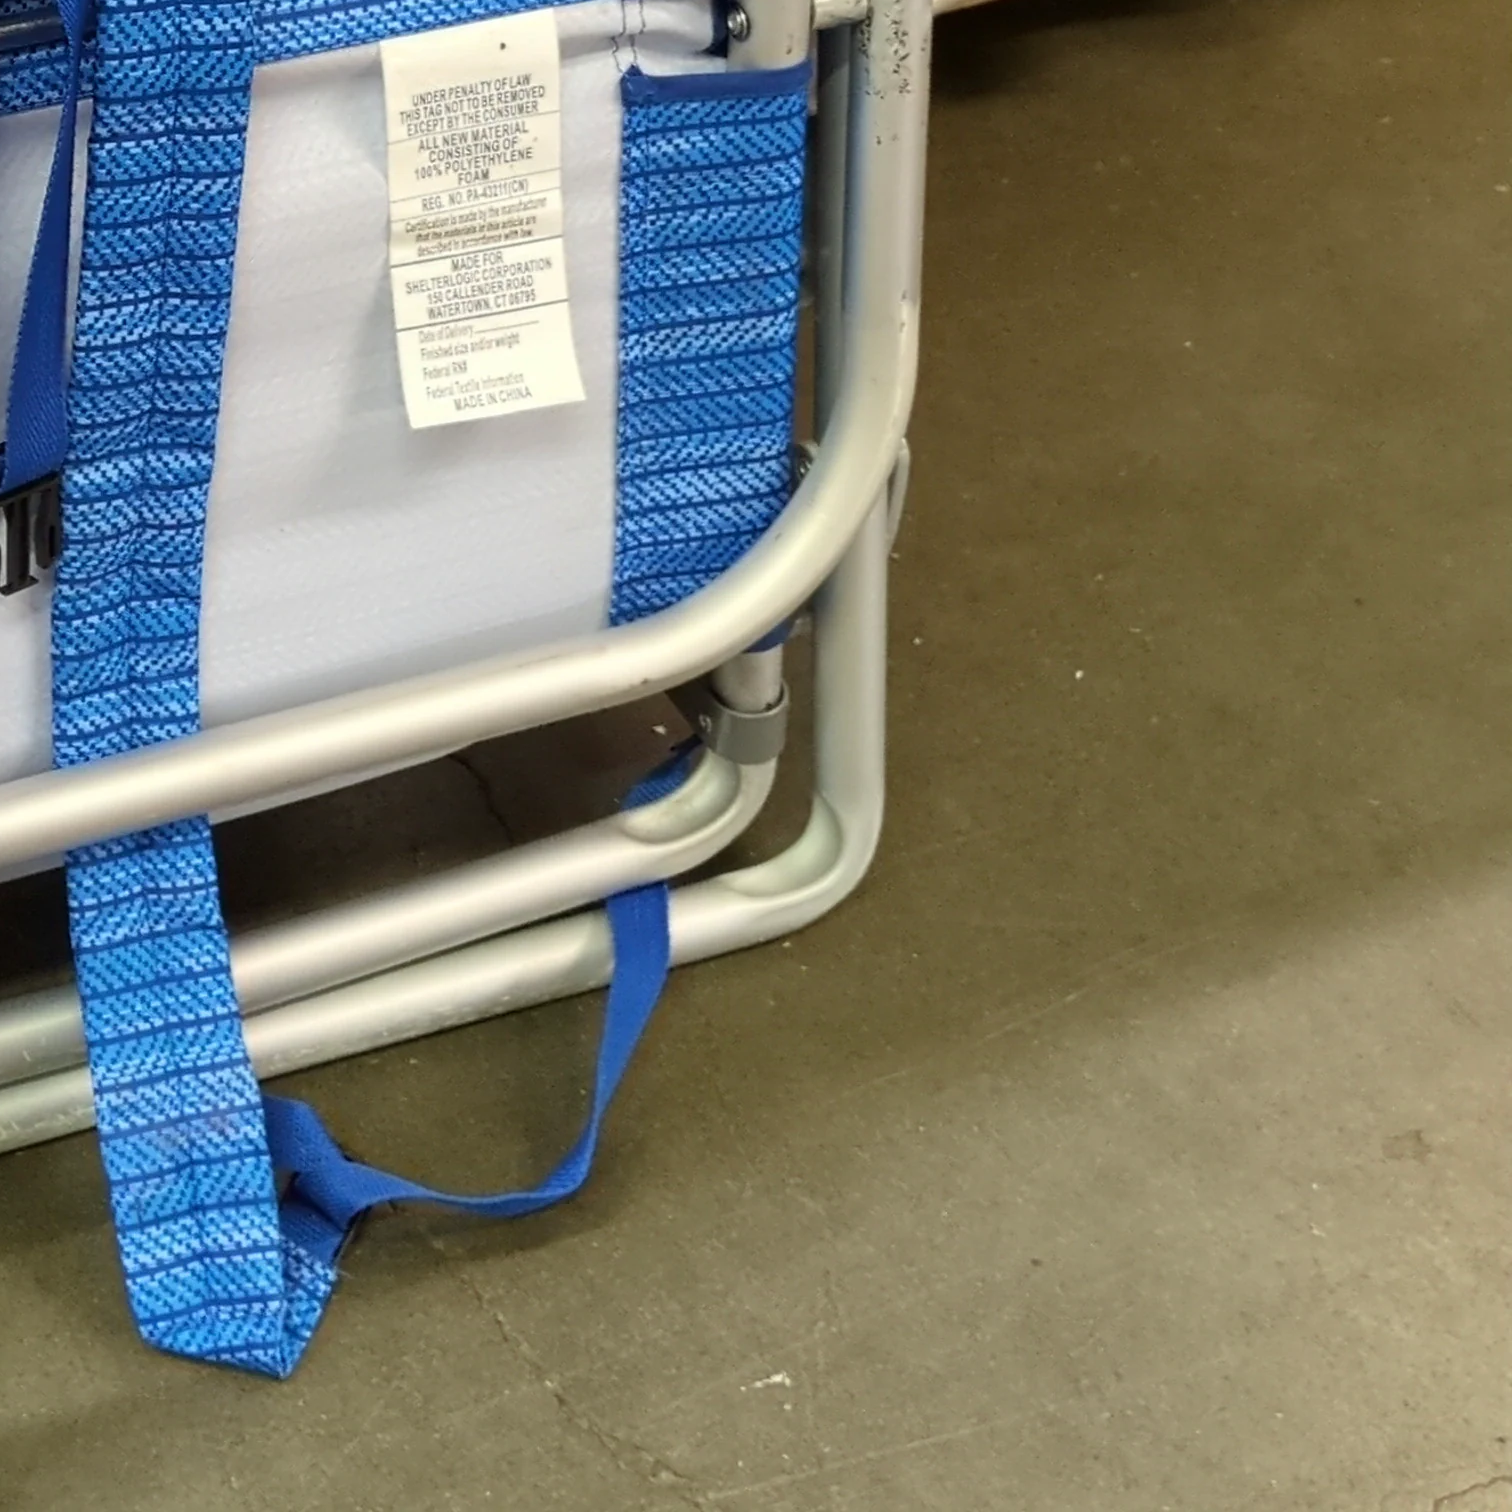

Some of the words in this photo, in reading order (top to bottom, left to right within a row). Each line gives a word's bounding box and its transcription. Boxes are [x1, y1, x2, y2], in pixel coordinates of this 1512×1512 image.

[413, 89, 446, 106] UNDER
[449, 80, 492, 99] PENALTY
[495, 78, 507, 91] OF
[510, 73, 531, 88] LAW
[400, 108, 421, 124] THIS
[423, 104, 442, 118] TAG
[445, 100, 465, 114] NOT
[467, 98, 479, 110] TO
[482, 95, 494, 107] BE
[498, 86, 545, 104] REMOVED
[407, 118, 444, 136] EXCEPT
[448, 115, 460, 128] BY
[463, 110, 481, 124] THE
[483, 101, 539, 121] CONSUMER
[419, 139, 439, 151] ALL
[442, 132, 468, 146] NEW
[472, 121, 528, 141] MATERIAL
[429, 140, 500, 162] CONSISTING
[503, 137, 518, 150] OF
[414, 164, 442, 180] 100%
[444, 147, 533, 174] POLYETHYLENE
[458, 168, 490, 185] FOAM
[422, 196, 444, 211] REG.
[405, 270, 480, 294] SHELTERLOGIC
[482, 257, 552, 281] CORPORATION
[452, 254, 480, 271] MADE
[483, 251, 504, 265] FOR
[427, 291, 442, 304] 150
[445, 280, 504, 301] CALLENDER
[506, 275, 533, 290] ROAD
[495, 294, 507, 308] CT
[454, 394, 485, 411] MADE
[487, 392, 497, 404] IN
[499, 386, 532, 402] CHINA
